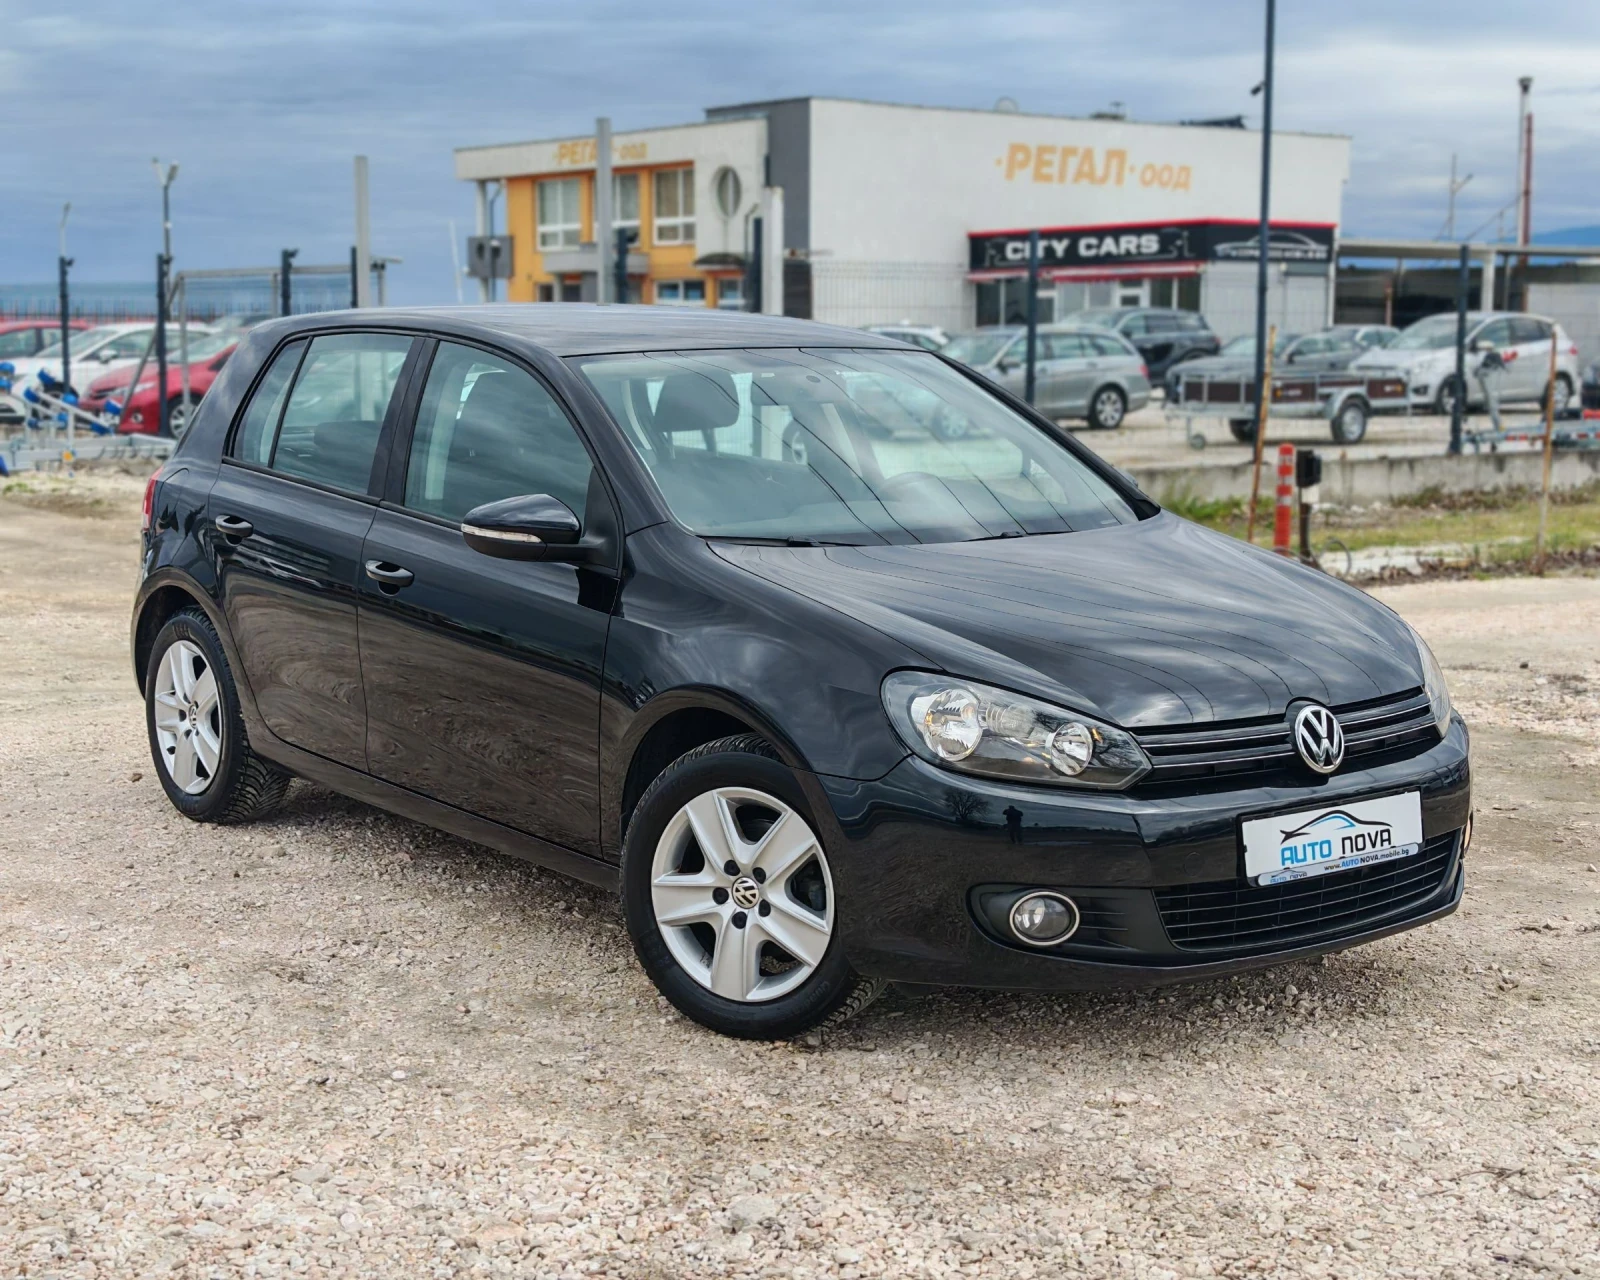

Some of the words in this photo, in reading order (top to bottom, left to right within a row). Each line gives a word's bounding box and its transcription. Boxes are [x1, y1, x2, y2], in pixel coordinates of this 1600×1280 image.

[557, 139, 615, 165] РЕГ
[1005, 142, 1128, 186] РЕГАЛ
[1004, 237, 1069, 261] CITY
[1078, 233, 1160, 258] CARS
[1280, 839, 1332, 867] AUTO
[1341, 828, 1393, 855] NOVA
